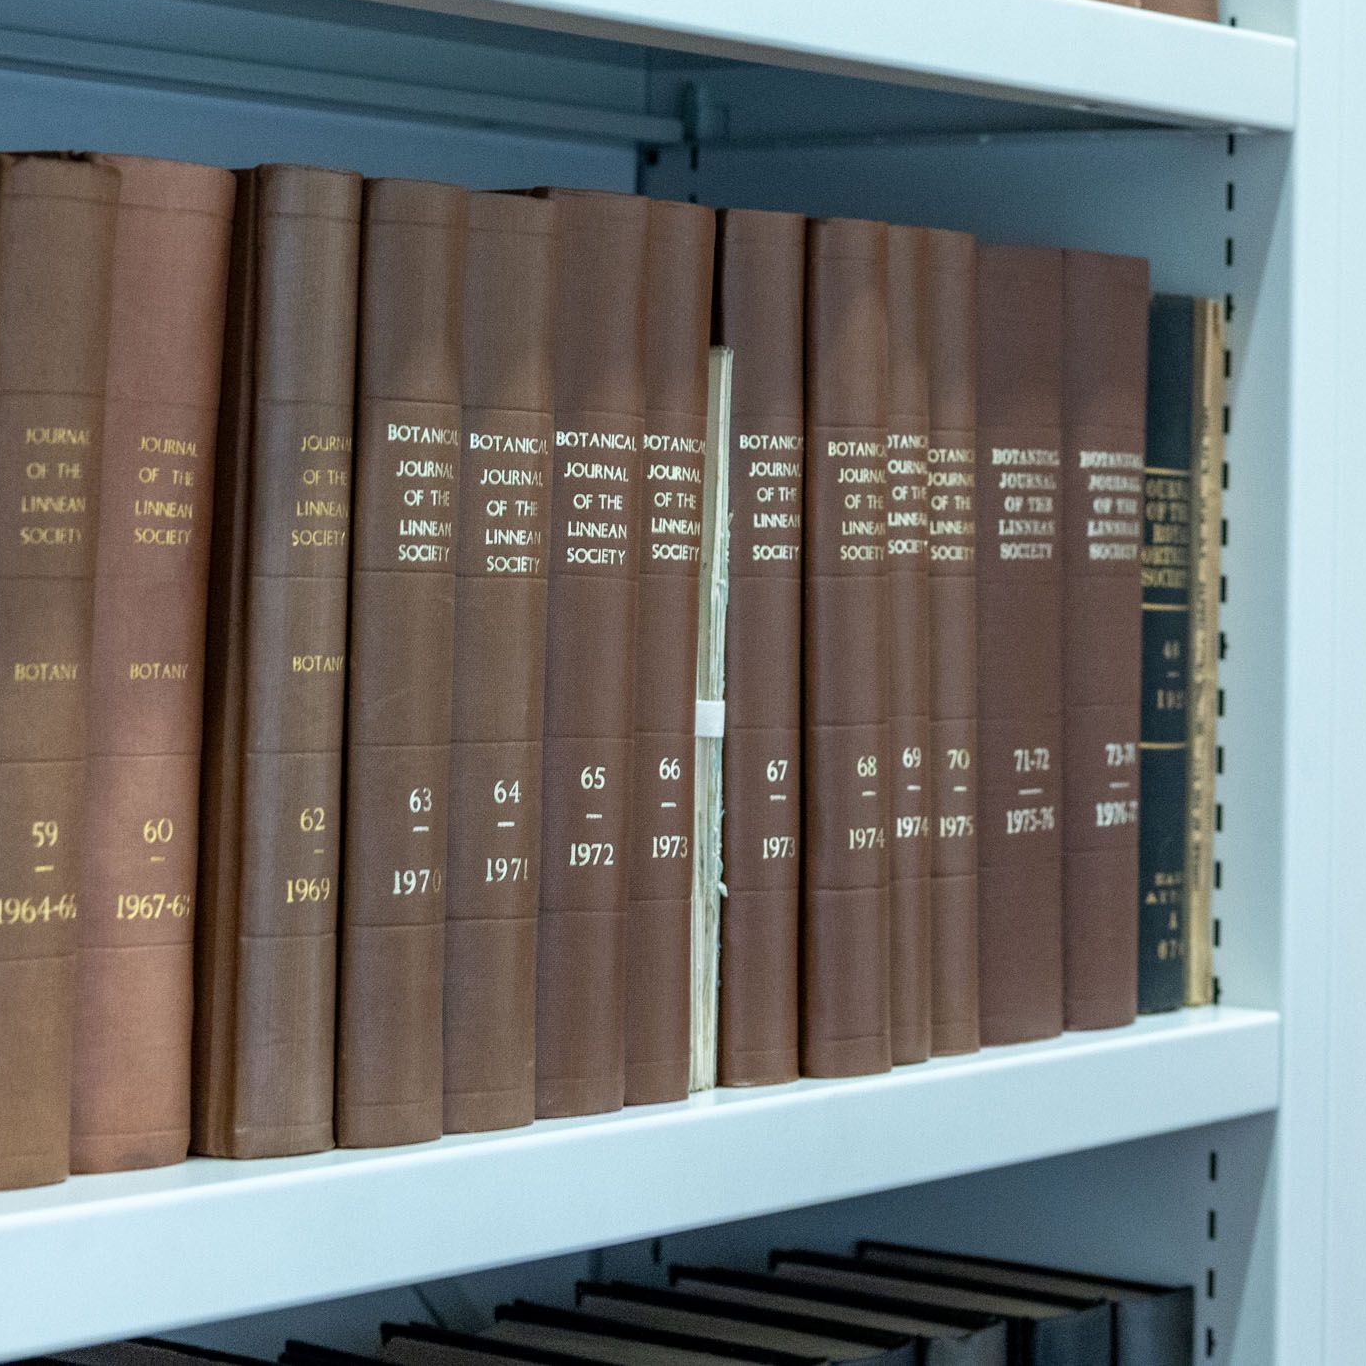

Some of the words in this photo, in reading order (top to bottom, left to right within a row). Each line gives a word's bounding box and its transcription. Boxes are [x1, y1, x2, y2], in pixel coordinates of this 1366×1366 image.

[387, 423, 459, 446] BOTANICAL
[469, 432, 549, 455] BOTANICAL
[555, 430, 637, 452] BOTANICAL
[138, 436, 198, 458] JOURNAL
[26, 462, 46, 479] OF
[58, 462, 83, 480] THE
[138, 467, 160, 484] OF
[171, 469, 194, 487] THE
[302, 469, 322, 485] OF
[326, 469, 348, 486] THE
[396, 460, 454, 480] JOURNAL
[480, 468, 544, 488] JOURNAL
[563, 461, 629, 483] JOURNAL
[647, 464, 702, 484] JOURNAL
[999, 472, 1058, 490] JOURNAL
[403, 489, 424, 507] OF
[430, 489, 450, 507] THE
[573, 493, 593, 510] OF
[598, 493, 623, 511] THE
[653, 492, 673, 508] OF
[676, 492, 697, 510] THE
[756, 487, 774, 503] OF
[844, 494, 862, 510] OF
[867, 494, 884, 510] THE
[892, 485, 908, 501] OF
[931, 495, 948, 511] OF
[135, 499, 193, 519] LINNEAN
[486, 499, 507, 517] OF
[515, 499, 538, 518] THE
[1003, 495, 1024, 513] OF
[399, 519, 452, 538] LINNEAN
[567, 520, 627, 540] LINNEAN
[651, 517, 701, 536] LINNEAN
[753, 513, 801, 529] LINNEAN
[134, 528, 193, 546] SOCIETY
[291, 529, 347, 547] SOCIETY
[485, 528, 541, 546] LINNEAN
[398, 544, 450, 563] SOCIETY
[566, 546, 627, 566] SOCIETY
[651, 543, 700, 562] SOCIETY
[752, 544, 799, 561] SOCIETY
[840, 544, 885, 562] SOCIETY
[999, 542, 1053, 560] SOCIETY
[486, 555, 540, 573] SOCIETY
[14, 662, 79, 682] BOTANY
[129, 662, 189, 681] BOTANY
[857, 755, 877, 777] 68
[902, 746, 922, 769] 69
[947, 748, 970, 770] 70
[1013, 747, 1051, 772] 71-72
[580, 766, 606, 790] 65
[658, 757, 681, 780] 66
[766, 759, 788, 782] 67
[409, 787, 432, 813] 63
[493, 779, 521, 803] 64
[299, 807, 326, 832] 62
[896, 815, 929, 838] 1974
[939, 815, 974, 838] 1975
[32, 820, 59, 848] 59
[143, 818, 174, 844] 60
[848, 827, 886, 850] 1974
[569, 842, 614, 866] 1972
[652, 835, 688, 859] 1973
[762, 836, 796, 860] 1973
[485, 857, 529, 882] 1971
[285, 878, 331, 904] 1969
[392, 868, 442, 895] 1970
